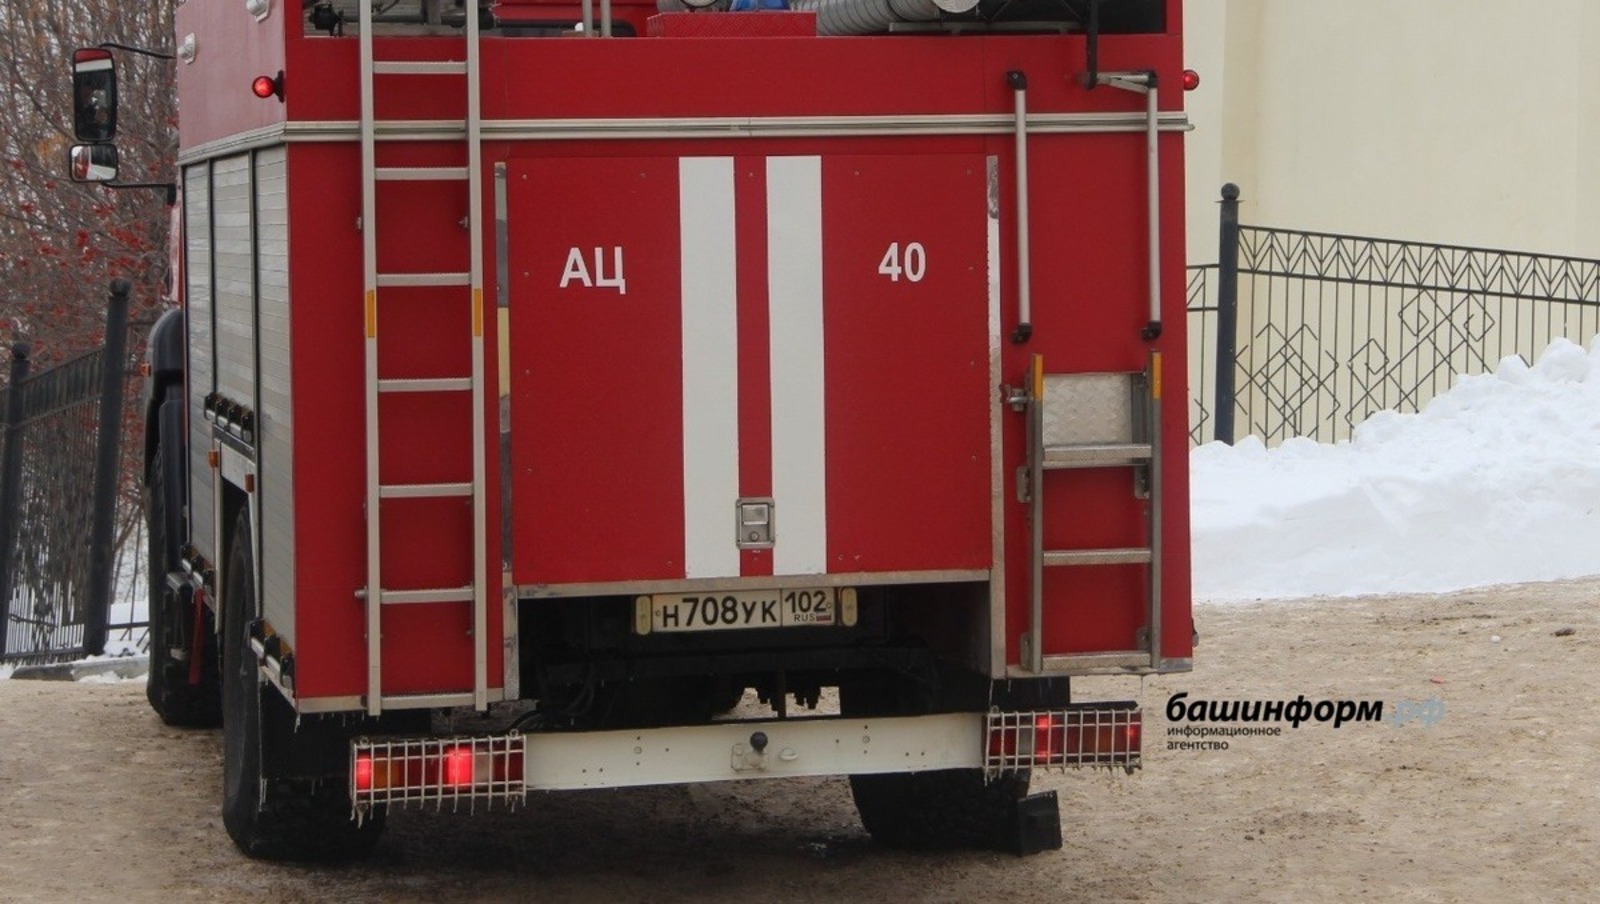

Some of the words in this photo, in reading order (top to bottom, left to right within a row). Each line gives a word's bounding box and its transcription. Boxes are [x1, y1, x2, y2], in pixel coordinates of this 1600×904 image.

[559, 246, 626, 295] АЦ
[878, 242, 926, 283] 40
[784, 590, 827, 613] 102
[794, 613, 815, 622] RUS
